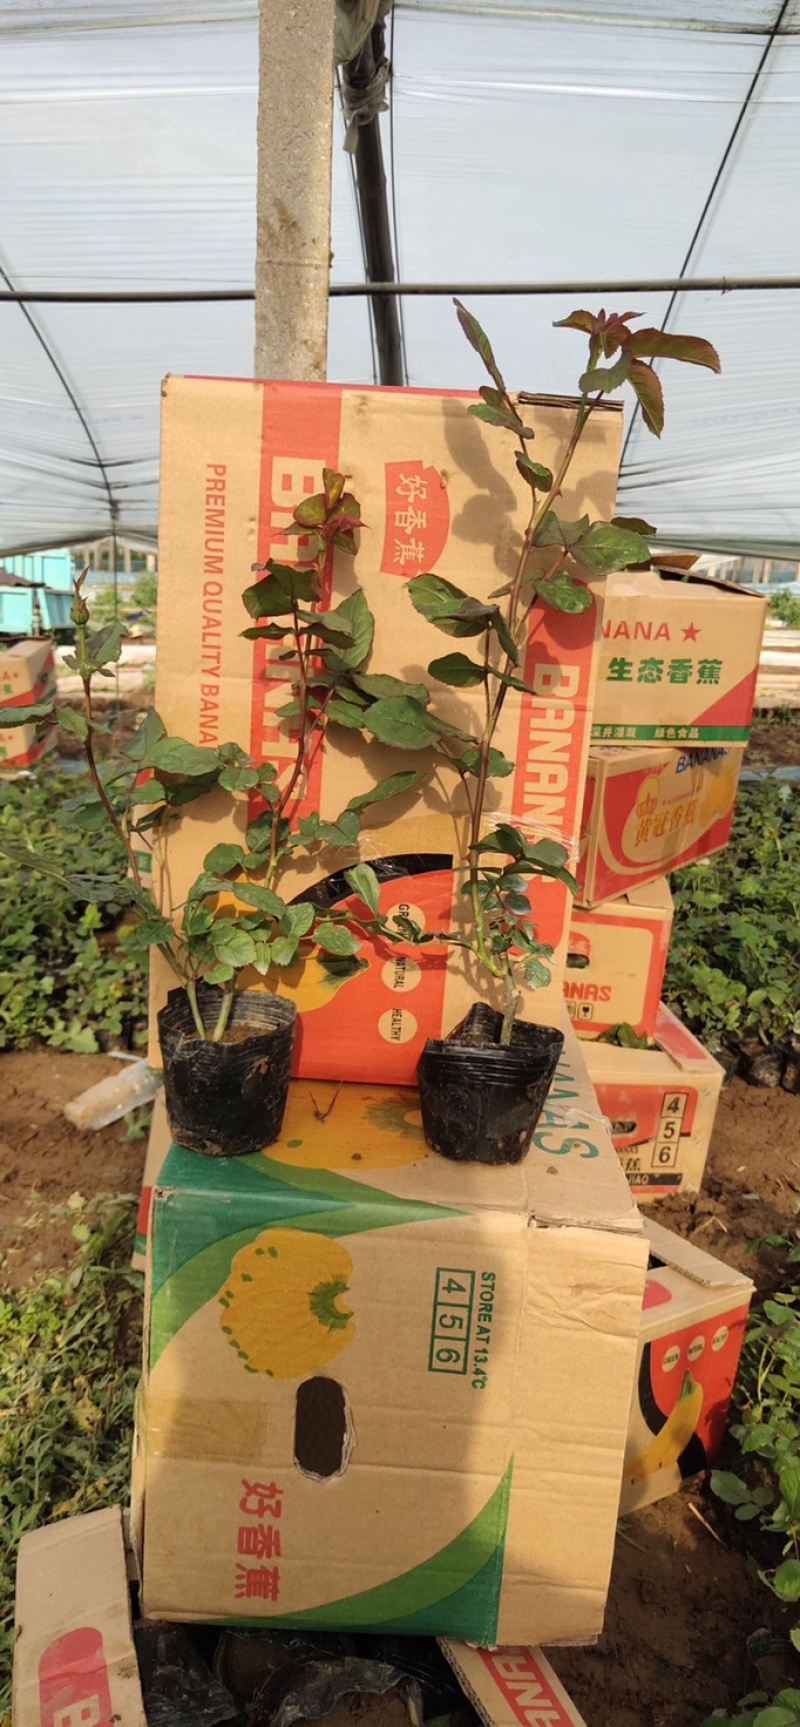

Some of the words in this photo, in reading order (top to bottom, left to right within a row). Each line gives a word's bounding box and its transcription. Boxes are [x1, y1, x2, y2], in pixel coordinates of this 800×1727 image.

[203, 463, 227, 575] PREMIUM
[393, 472, 429, 566] 好香蕉
[201, 581, 224, 678] QUALITY
[606, 657, 723, 685] 生态香蕉
[199, 684, 220, 751] BANA
[519, 663, 580, 883] BANAN
[393, 956, 406, 988] NATURAL
[390, 1008, 403, 1041] HEALTHY
[667, 1096, 680, 1113] 4
[663, 1121, 676, 1139] 5
[658, 1146, 671, 1164] 6
[442, 1278, 466, 1294] 4
[478, 1271, 496, 1323] STORE
[438, 1314, 463, 1330] 5
[475, 1325, 491, 1345] AT
[435, 1348, 461, 1363] 6
[234, 1478, 284, 1602] 好香蕉
